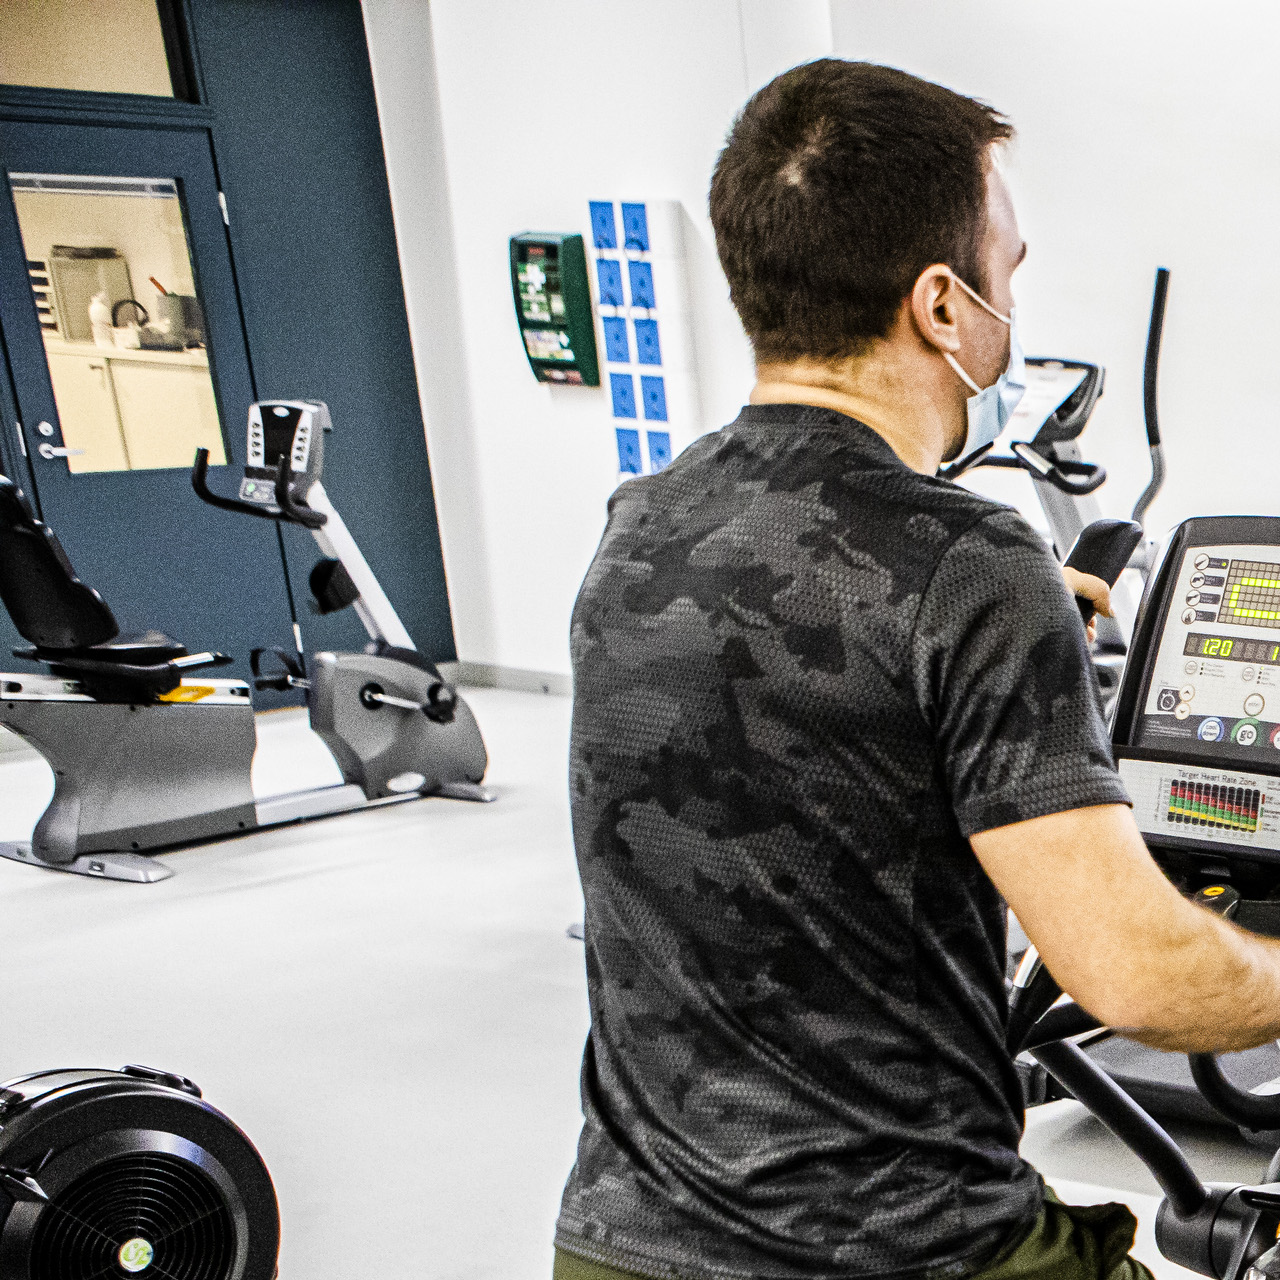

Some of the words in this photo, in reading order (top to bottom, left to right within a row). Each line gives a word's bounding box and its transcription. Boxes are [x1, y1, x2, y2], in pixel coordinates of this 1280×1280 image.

[1239, 730, 1254, 742] go
[1178, 769, 1199, 780] Target
[1202, 772, 1220, 782] Heart
[1222, 775, 1237, 784] Rate
[1239, 777, 1257, 787] Zone
